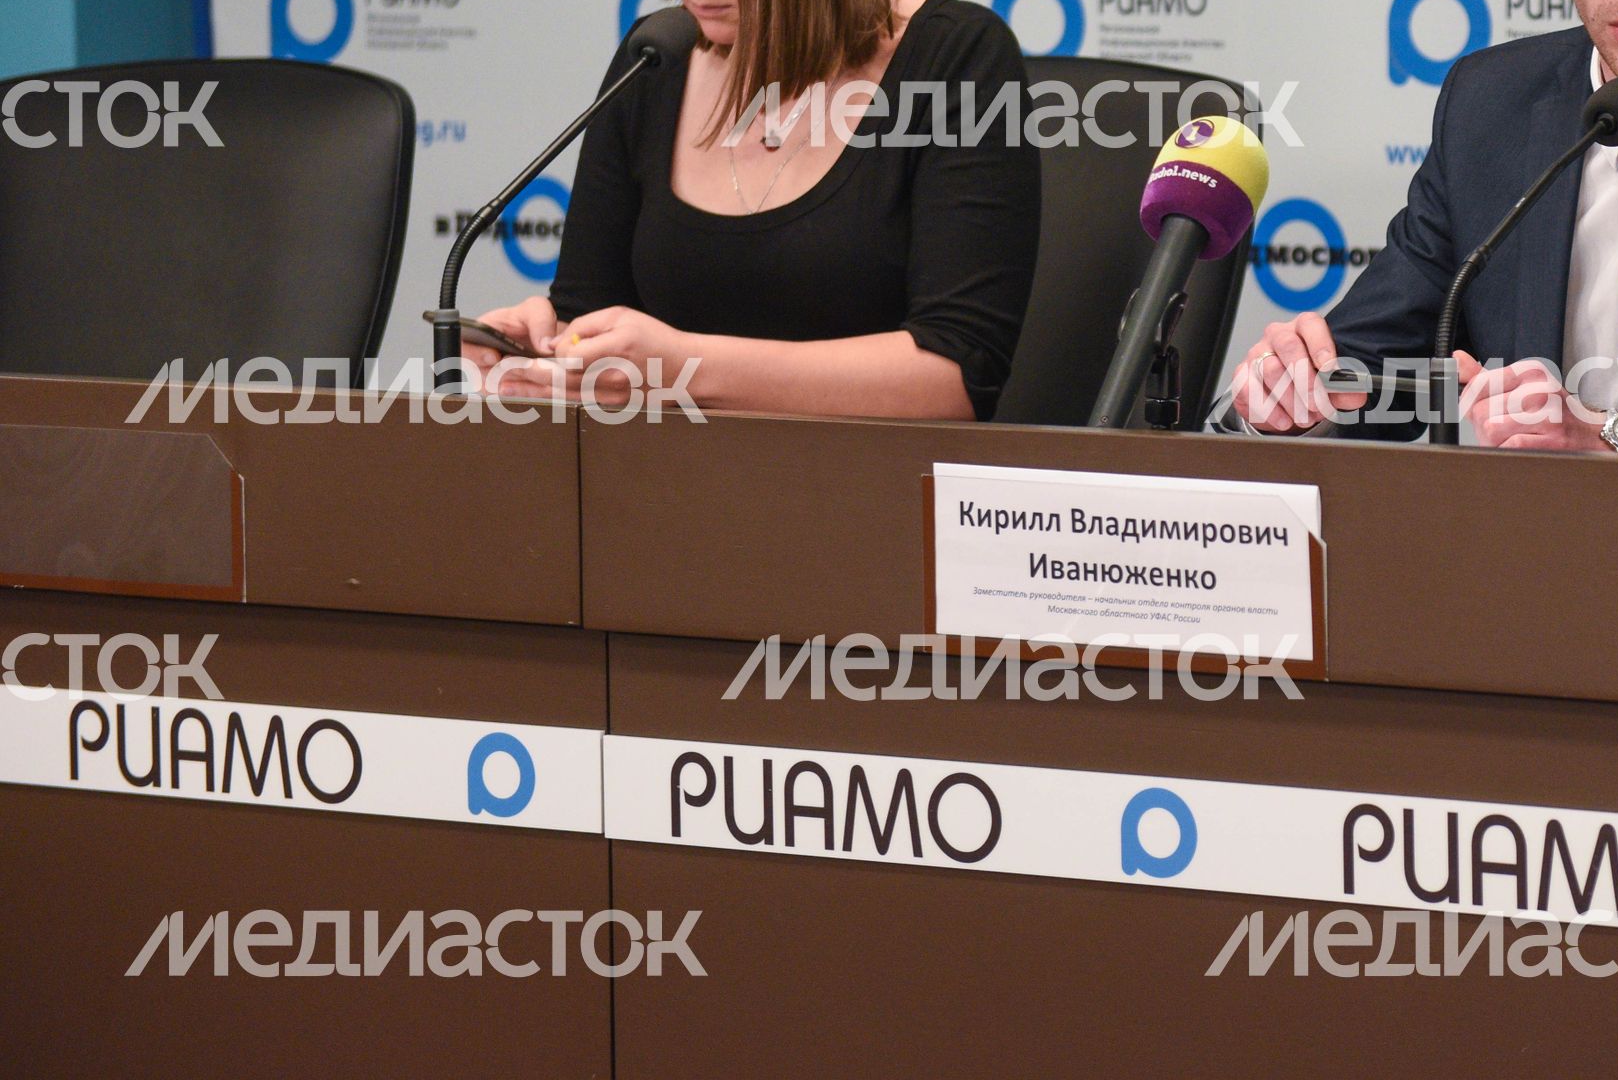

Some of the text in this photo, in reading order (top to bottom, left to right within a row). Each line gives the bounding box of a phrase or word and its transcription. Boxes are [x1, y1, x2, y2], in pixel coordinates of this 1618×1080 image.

[958, 500, 1290, 548] Кирилл Владимирович
[1029, 553, 1217, 591] Иванюженко
[973, 586, 1027, 599] Заместитель
[1029, 591, 1086, 602] руководителя
[1094, 597, 1136, 606] начальник
[1138, 599, 1169, 608] отдела
[1171, 602, 1211, 611] контроля
[1212, 605, 1246, 615] органов
[1247, 607, 1279, 616] власти
[1047, 605, 1201, 624] Московского областного УФАС России
[69, 699, 363, 804] РИАМО
[670, 751, 1003, 864] РИАМО
